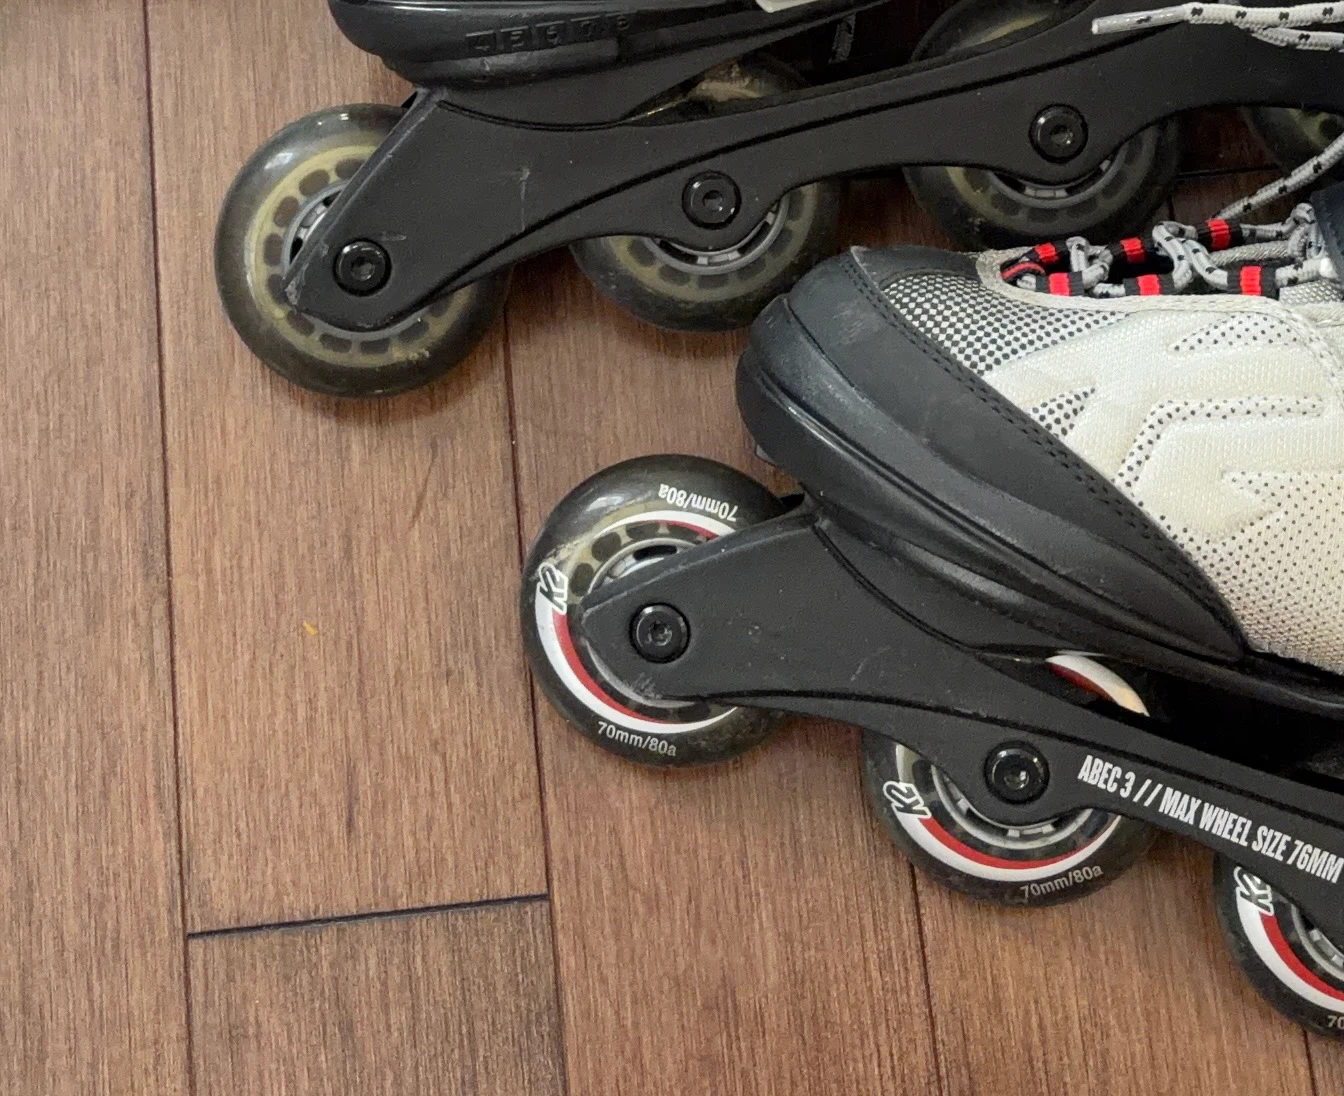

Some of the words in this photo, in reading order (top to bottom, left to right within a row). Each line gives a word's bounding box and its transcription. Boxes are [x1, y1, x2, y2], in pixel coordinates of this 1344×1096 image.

[658, 483, 739, 522] 70mm/80a
[536, 562, 568, 615] K2
[597, 720, 677, 757] 70mm/80a
[883, 780, 932, 819] K2
[1077, 755, 1121, 794] ABEC
[1119, 772, 1136, 798] 3
[1159, 787, 1202, 826] MAX
[1198, 802, 1253, 847] WHEEL
[1252, 825, 1292, 862] SIZE
[1019, 865, 1104, 899] 70mm/80a
[1233, 866, 1275, 916] K2
